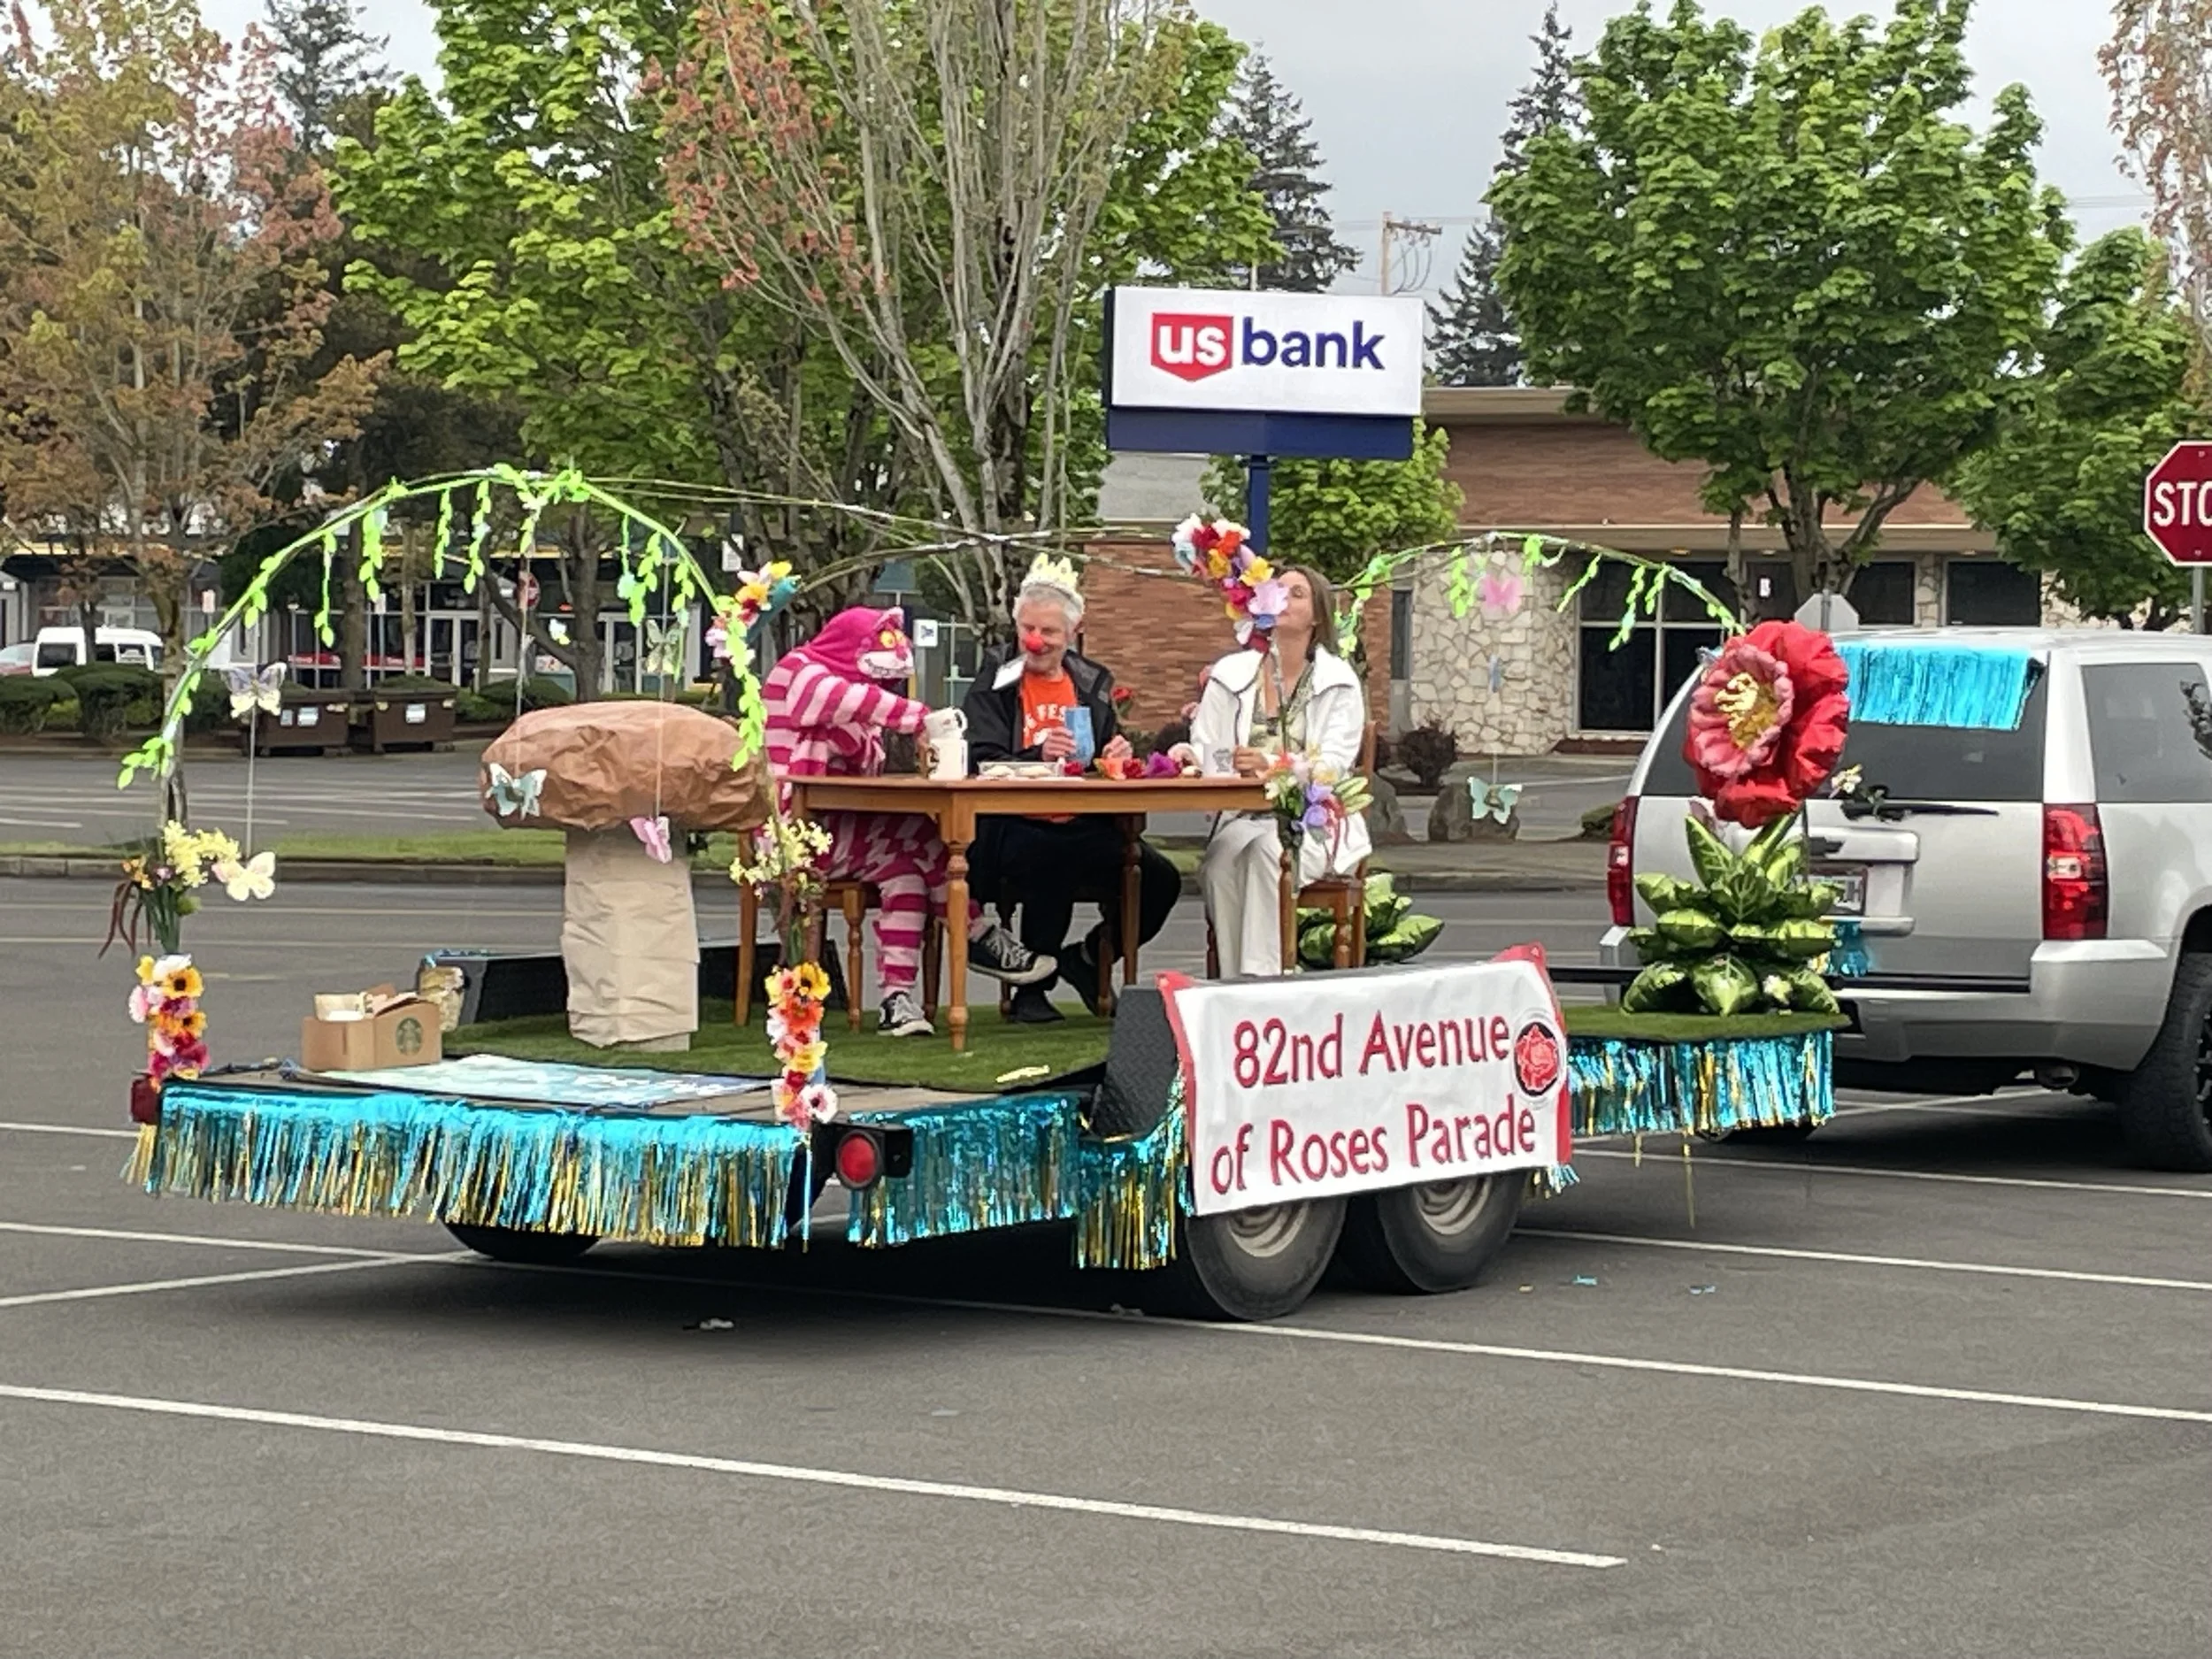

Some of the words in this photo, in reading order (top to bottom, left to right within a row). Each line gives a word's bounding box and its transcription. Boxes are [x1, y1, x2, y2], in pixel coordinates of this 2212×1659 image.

[1242, 316, 1386, 370] bank
[1233, 1012, 1343, 1089] 82nd
[1359, 1010, 1509, 1076] Avenue
[1211, 1122, 1254, 1195] of
[1271, 1118, 1389, 1187] Roses
[1406, 1093, 1536, 1168] Parade
